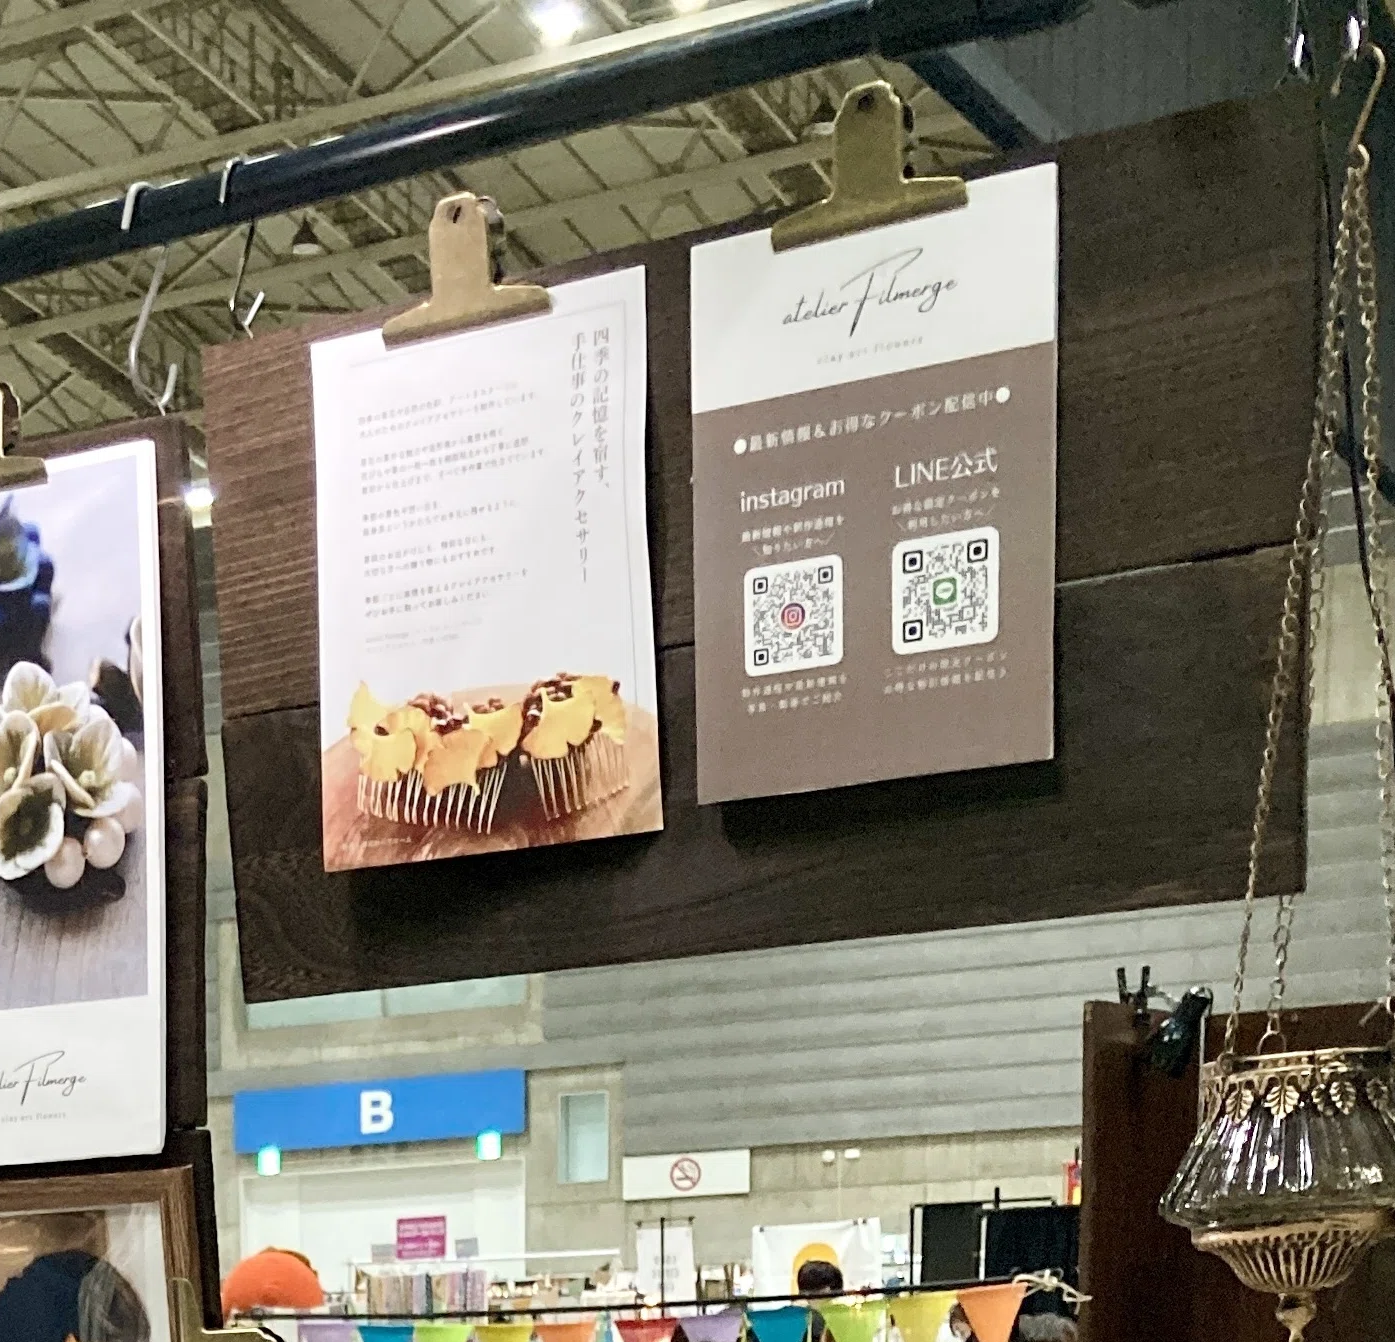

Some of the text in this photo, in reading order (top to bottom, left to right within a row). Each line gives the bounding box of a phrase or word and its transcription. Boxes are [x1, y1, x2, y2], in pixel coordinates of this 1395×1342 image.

[782, 287, 848, 326] atelier
[895, 446, 998, 489] LINE公式
[740, 479, 845, 513] instagram
[360, 1090, 395, 1135] B
